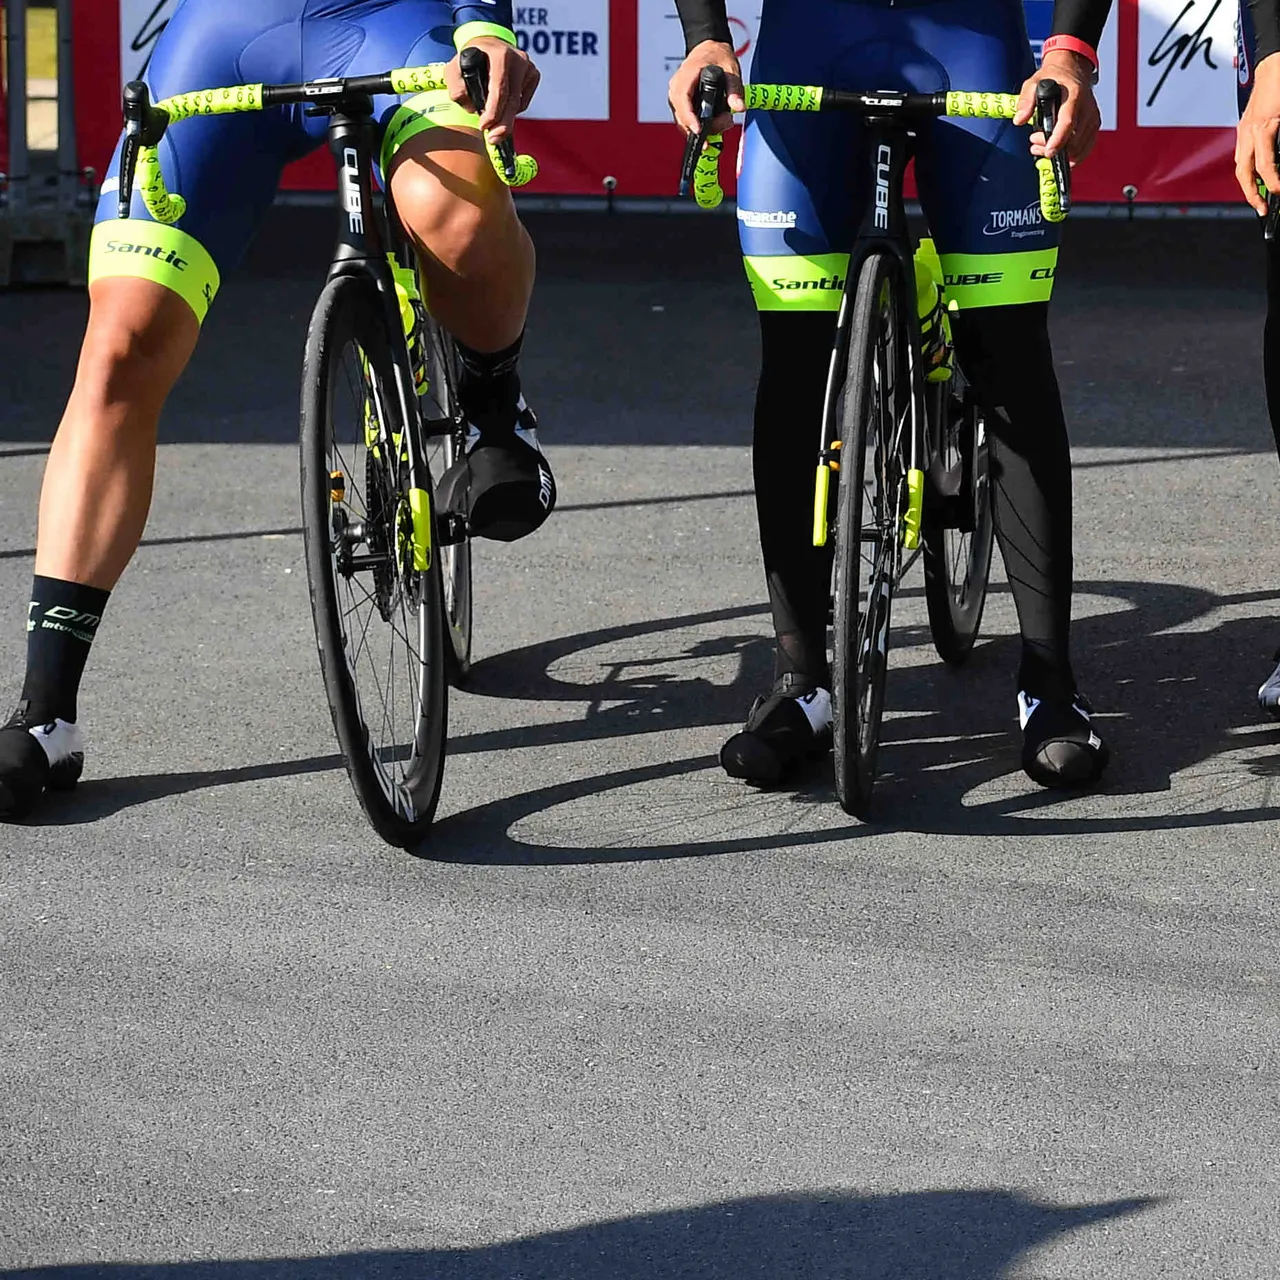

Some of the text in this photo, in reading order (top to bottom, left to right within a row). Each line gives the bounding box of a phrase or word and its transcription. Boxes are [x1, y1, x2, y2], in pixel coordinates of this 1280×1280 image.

[305, 85, 343, 96] CUBE
[864, 96, 903, 106] CUBE
[344, 148, 364, 235] CUBE
[874, 145, 890, 230] CUBE
[991, 209, 1042, 230] TORMANS
[1011, 228, 1045, 238] Engineering
[104, 239, 189, 272] Santic
